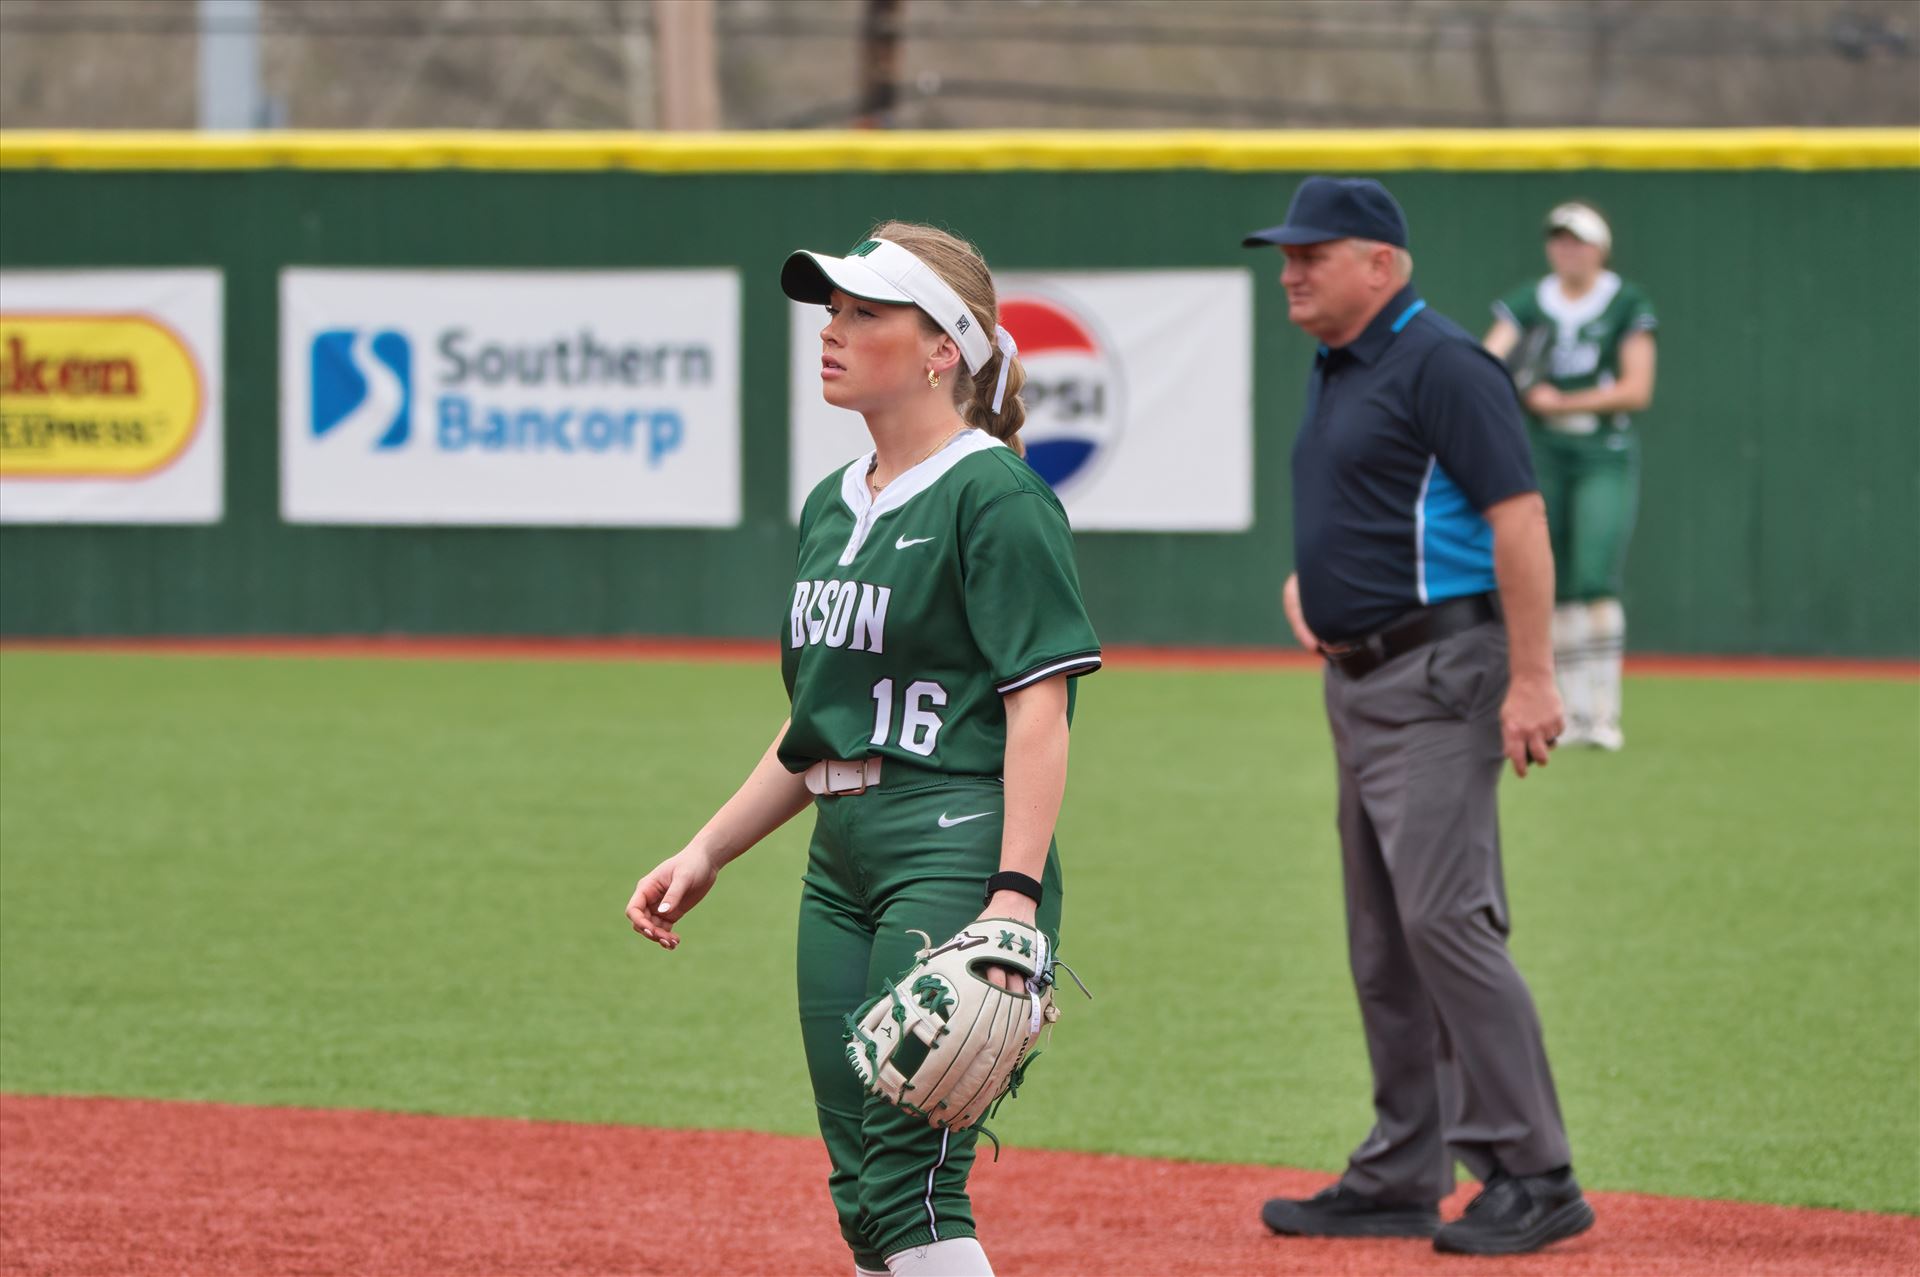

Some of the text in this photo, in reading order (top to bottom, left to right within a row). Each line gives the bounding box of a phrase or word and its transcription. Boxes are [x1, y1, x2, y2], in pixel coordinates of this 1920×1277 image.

[437, 329, 712, 384] Southern
[437, 395, 684, 467] Bancorp
[1020, 379, 1104, 423] PSI
[789, 578, 892, 654] BISON
[868, 677, 948, 757] 16
